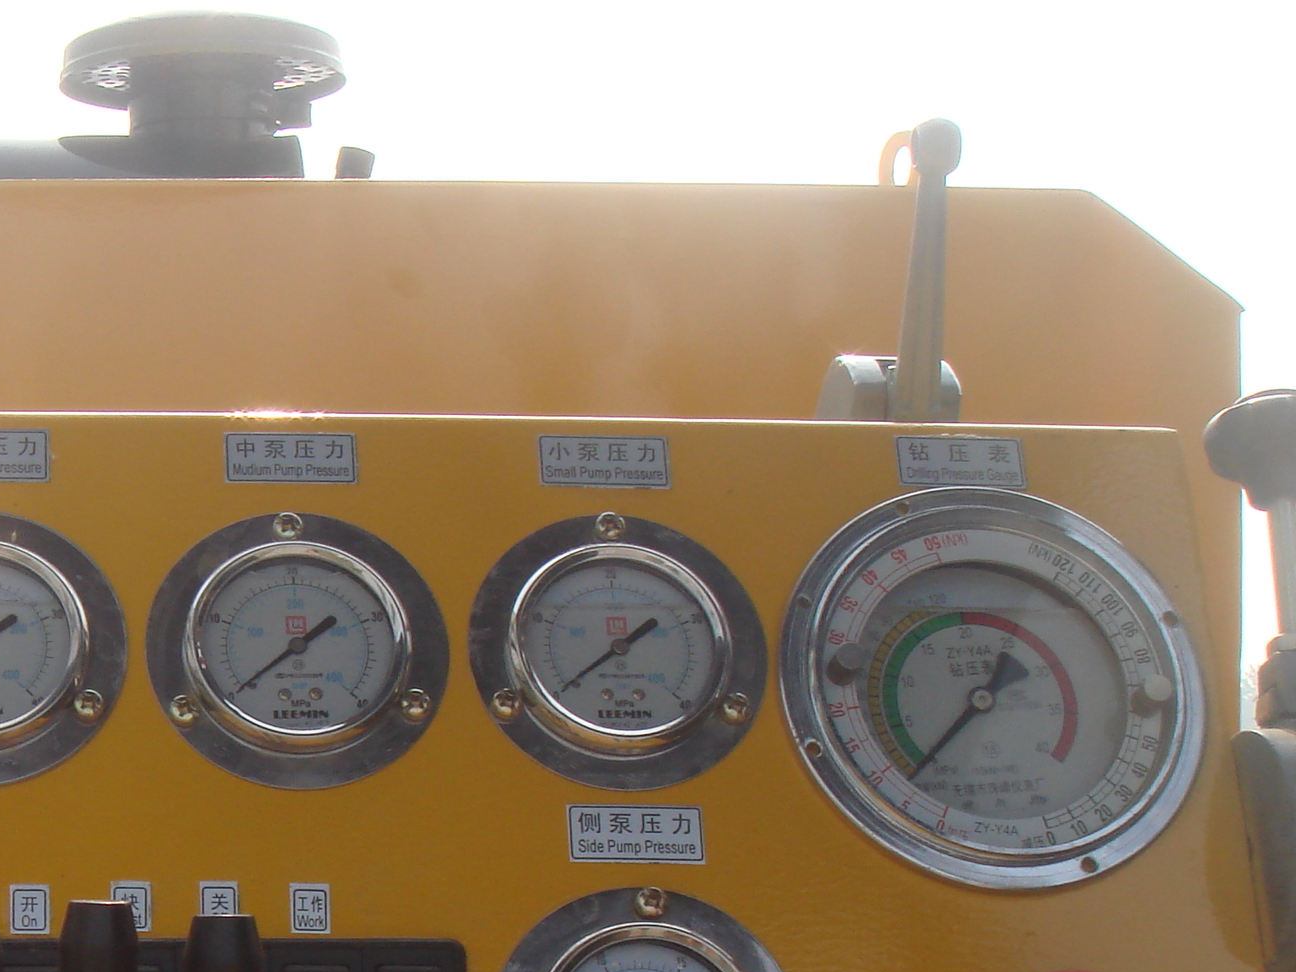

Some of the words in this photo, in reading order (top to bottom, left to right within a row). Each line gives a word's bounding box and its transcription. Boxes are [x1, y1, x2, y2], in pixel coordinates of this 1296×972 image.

[236, 438, 344, 459] 中泵压力
[549, 442, 656, 462] 小泵压力
[908, 443, 1010, 463] 钻压表
[233, 463, 272, 475] Mudium
[274, 464, 303, 478] Pump
[306, 464, 350, 477] Pressure
[545, 465, 576, 478] Small
[579, 466, 612, 480] Pump
[615, 467, 663, 479] Pressure
[906, 467, 938, 482] Drilling
[941, 467, 984, 480] Pressure
[987, 468, 1018, 483] Gauge
[924, 535, 941, 551] 50
[891, 549, 908, 564] 45
[1054, 554, 1075, 575] 120
[605, 571, 616, 579] 20
[861, 569, 878, 586] 40
[1079, 571, 1102, 594] 110
[840, 595, 858, 613] 35
[1101, 593, 1124, 615] 100
[51, 609, 63, 620] 30
[208, 613, 220, 623] 10
[372, 611, 383, 622] 30
[691, 613, 702, 624] 30
[828, 629, 845, 645] 30
[958, 627, 972, 639] 20
[1121, 621, 1138, 638] 90
[921, 644, 935, 655] 15
[1000, 637, 1014, 650] 25
[945, 645, 993, 659] ZY-Y4A
[1134, 648, 1151, 664] 80
[901, 676, 914, 688] 10
[679, 700, 691, 709] 40
[828, 702, 846, 717] 20
[1048, 703, 1062, 716] 35
[273, 709, 329, 719] LEEMIN
[598, 710, 652, 719] LEEMIN
[905, 715, 913, 728] 5
[844, 737, 861, 754] 15
[1142, 735, 1158, 751] 50
[866, 770, 884, 786] 10
[1132, 762, 1148, 779] 40
[1114, 784, 1133, 802] 30
[901, 800, 911, 810] 5
[1095, 804, 1112, 822] 20
[578, 812, 691, 835] 侧泵压力
[974, 821, 1019, 836] ZY-Y4A
[1070, 819, 1088, 837] 10
[1046, 831, 1056, 846] 0
[578, 839, 604, 853] Side
[607, 839, 641, 855] Pump
[645, 840, 696, 854] Pressure
[21, 896, 38, 912] 开
[211, 893, 228, 911] 关
[297, 896, 323, 912] 工作
[22, 914, 37, 928] On
[297, 915, 325, 929] Work
